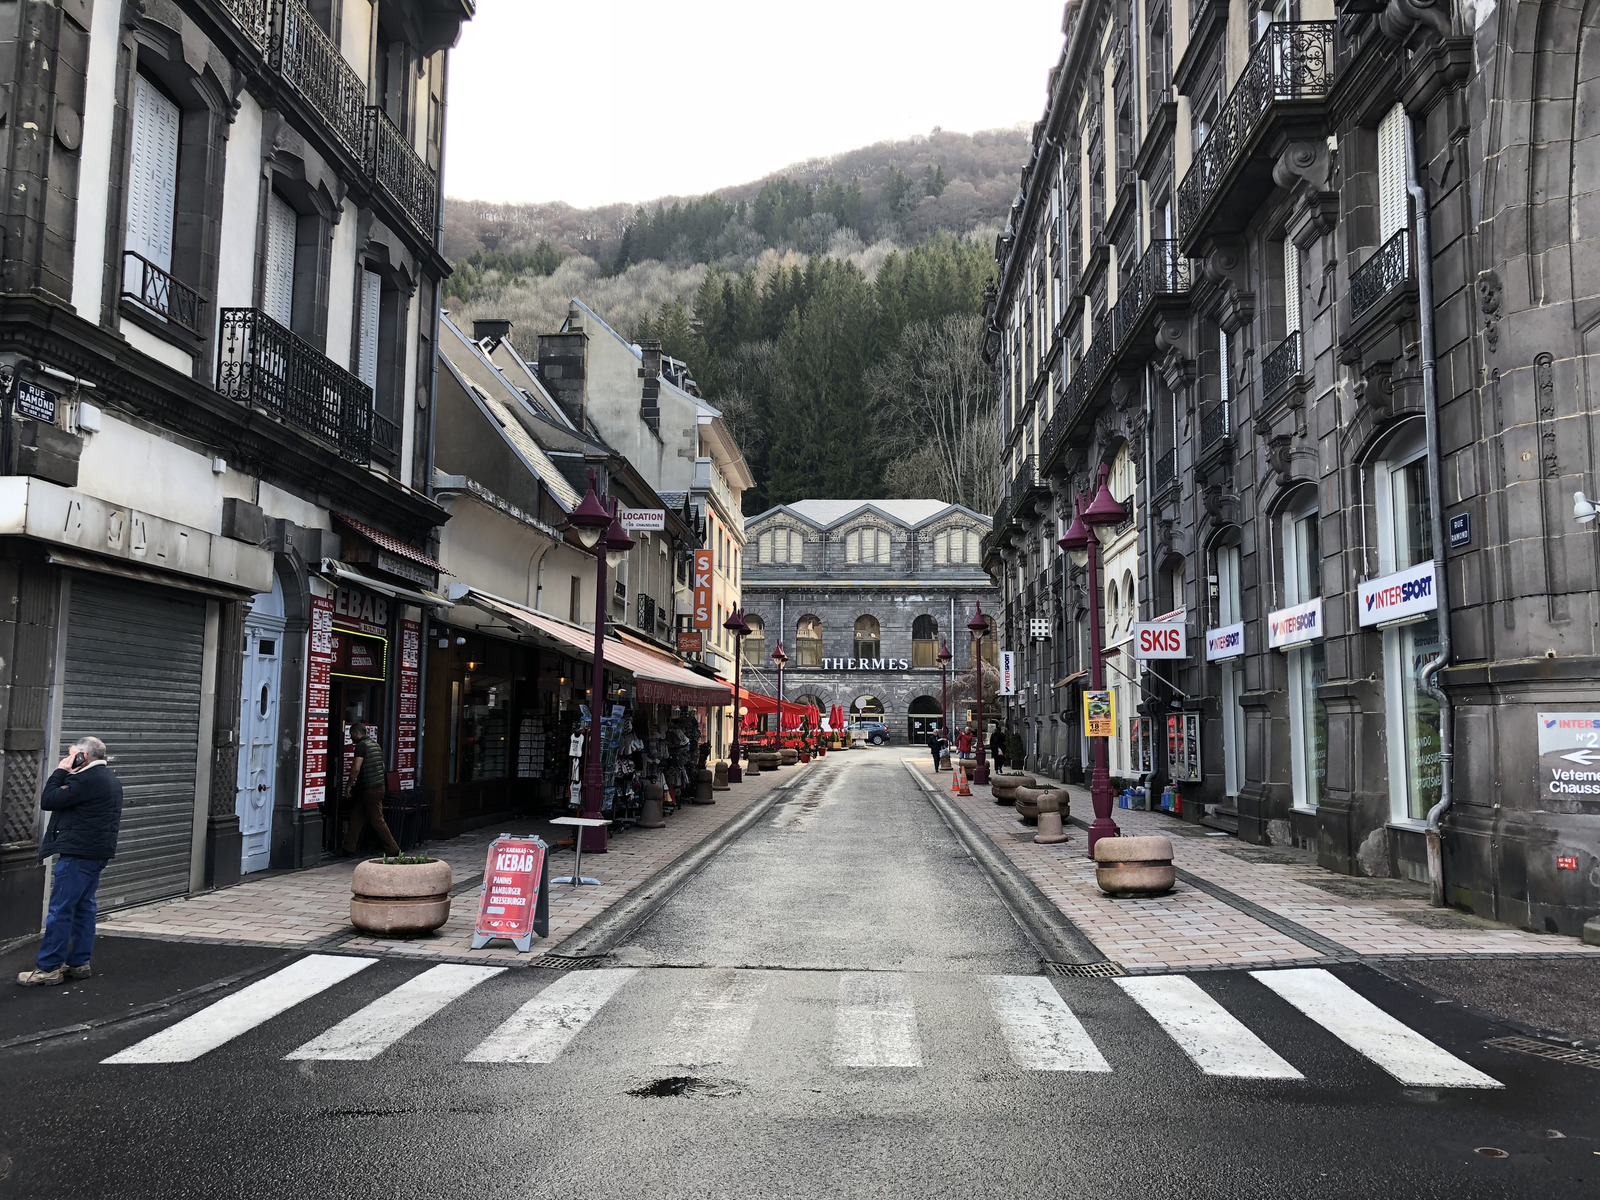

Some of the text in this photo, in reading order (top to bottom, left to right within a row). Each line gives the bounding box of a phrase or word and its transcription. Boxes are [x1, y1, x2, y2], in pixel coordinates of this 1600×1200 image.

[30, 386, 45, 398] RUE
[20, 391, 54, 411] RAMOND
[622, 512, 663, 521] LOCATION
[1454, 519, 1464, 529] RUE
[1451, 530, 1468, 543] RAMOND
[695, 556, 711, 622] SKIS
[1375, 575, 1432, 610] INTERSPORT
[334, 587, 388, 626] EBAB
[1279, 610, 1317, 636] INTERSPORT
[1140, 629, 1181, 652] SKIS
[1213, 631, 1240, 651] INTERSPORT
[821, 657, 909, 671] THERMES
[1559, 719, 1600, 728] INTERS
[496, 854, 534, 872] KEBAB
[493, 877, 512, 885] PANINIS
[492, 886, 521, 895] HAMBURGER
[490, 896, 526, 905] CHEESEBURGER
